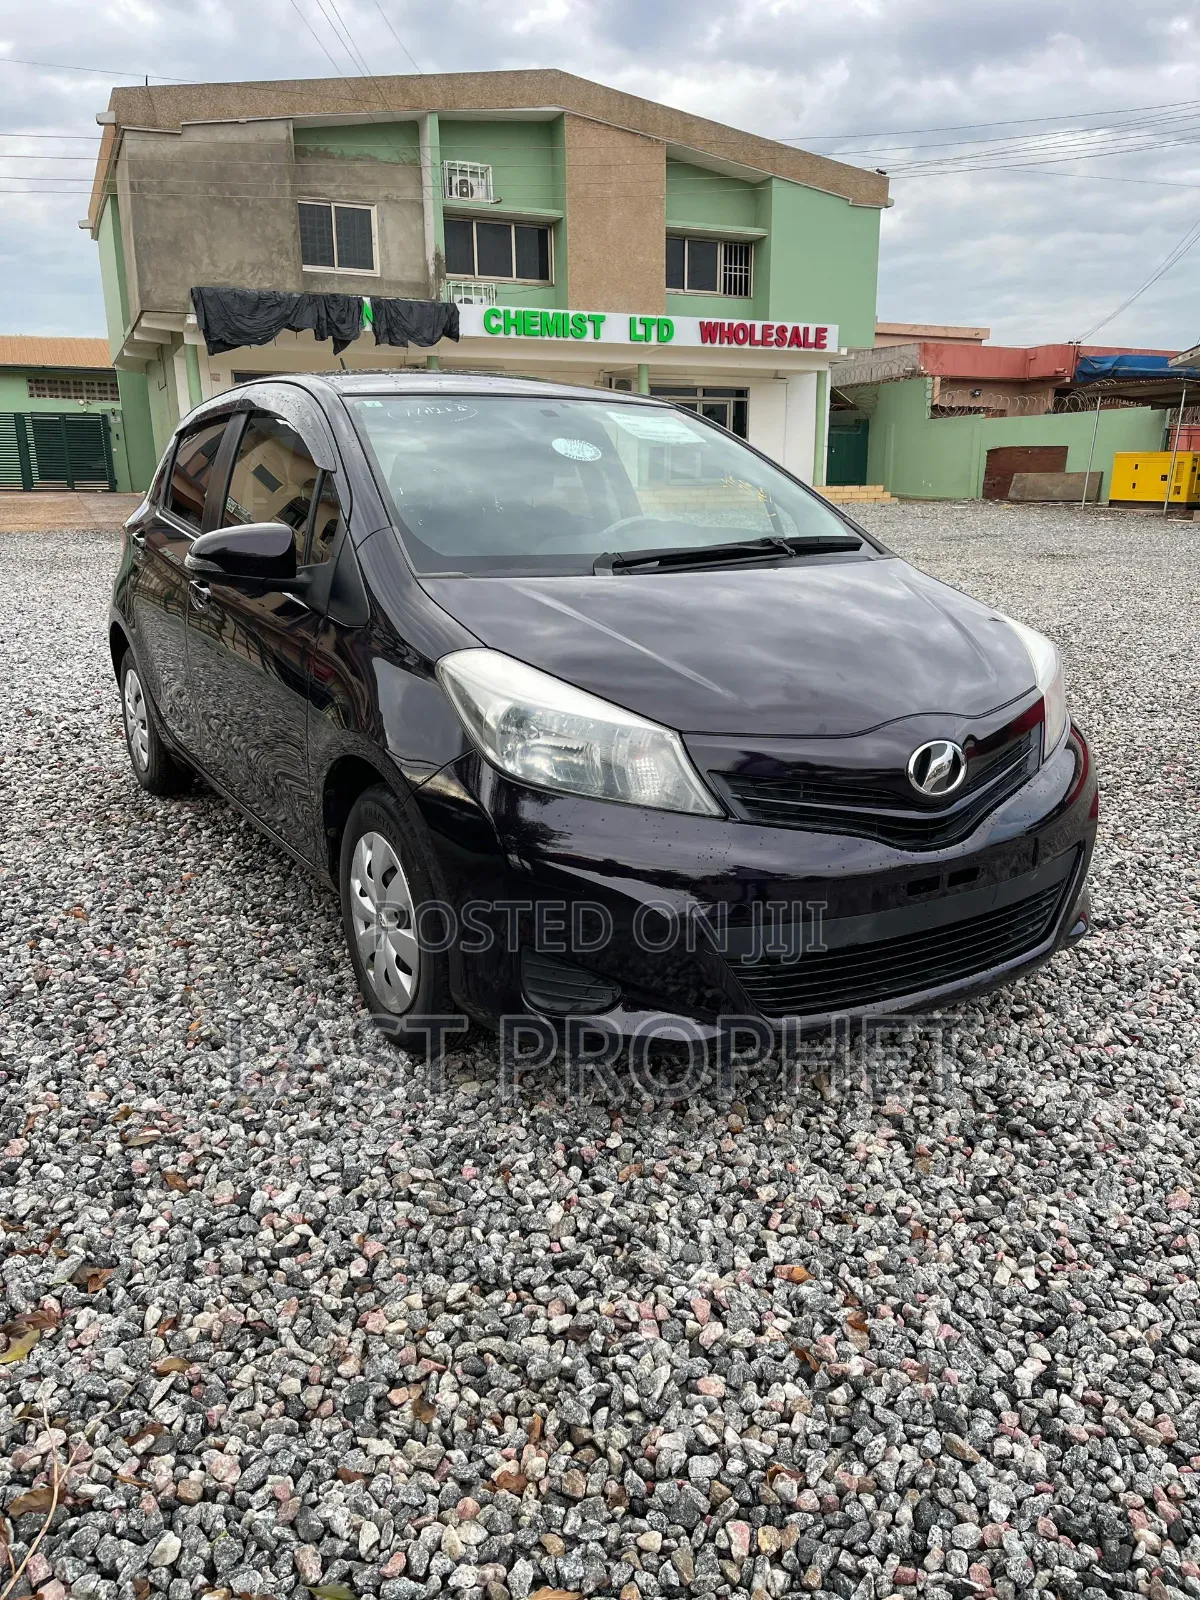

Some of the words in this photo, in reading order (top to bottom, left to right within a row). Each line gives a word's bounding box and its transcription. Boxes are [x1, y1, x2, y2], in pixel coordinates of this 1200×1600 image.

[483, 307, 606, 339] CHEMIST
[629, 316, 675, 342] LTD
[699, 321, 828, 349] WHOLESALE
